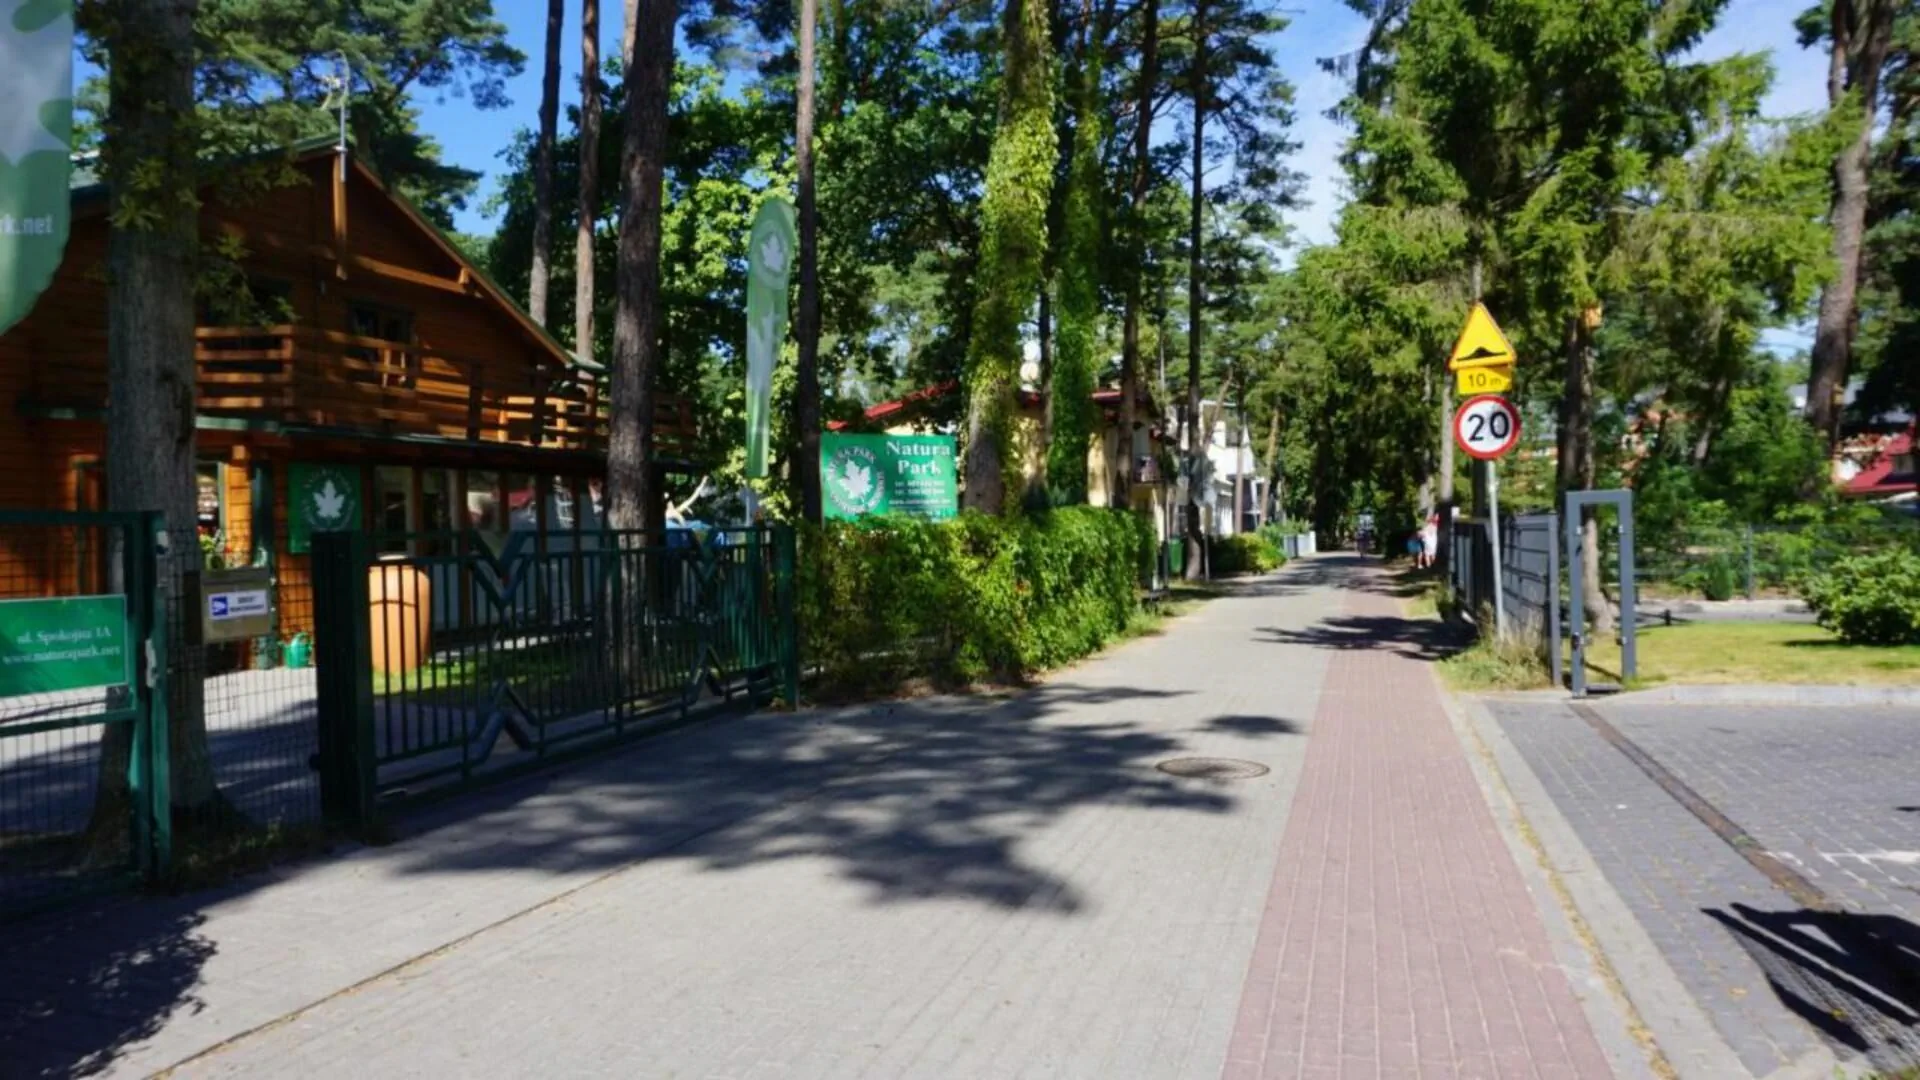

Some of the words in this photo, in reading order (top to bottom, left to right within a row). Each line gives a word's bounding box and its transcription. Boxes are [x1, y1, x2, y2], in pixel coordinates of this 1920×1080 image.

[1468, 373, 1487, 387] 10
[1490, 378, 1502, 386] m
[1467, 411, 1510, 442] 20
[886, 440, 951, 456] Natura
[897, 459, 942, 476] Park
